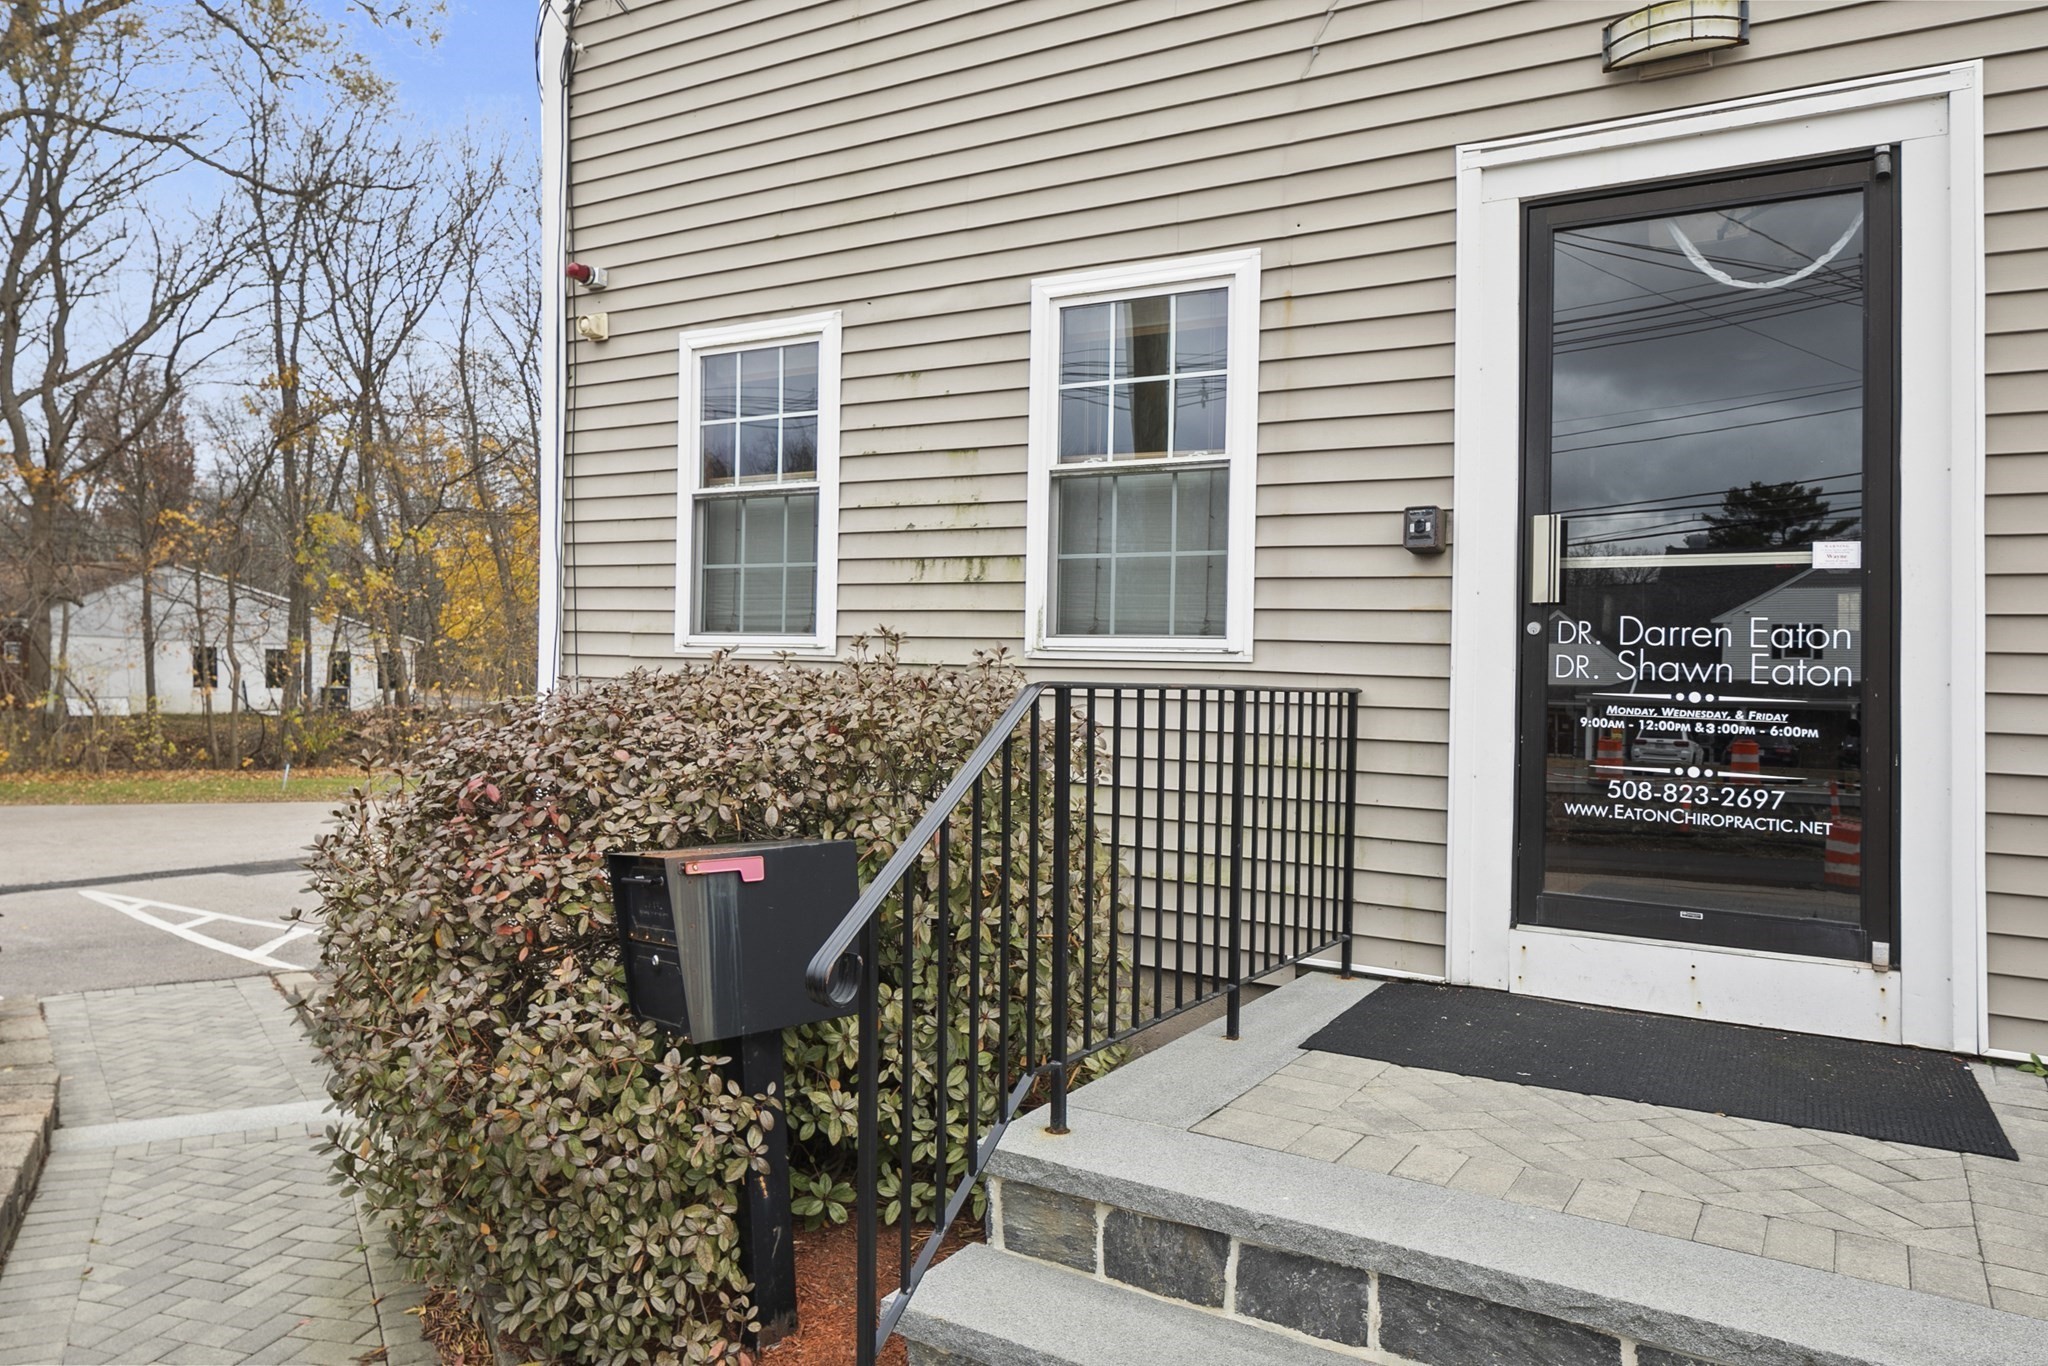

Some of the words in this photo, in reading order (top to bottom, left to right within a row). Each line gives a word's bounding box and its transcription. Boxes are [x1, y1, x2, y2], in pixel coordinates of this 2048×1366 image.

[1558, 620, 1601, 646] DR.
[1619, 615, 1732, 648] Darren
[1750, 616, 1852, 650] Eaton
[1555, 654, 1599, 680] DR.
[1616, 649, 1733, 683] Shawn
[1751, 653, 1852, 687] Eaton
[1638, 719, 1691, 732] 12:00PM
[1769, 725, 1819, 738] 6:00PM
[1735, 710, 1744, 720] &
[1606, 780, 1786, 811] 508-823-2697
